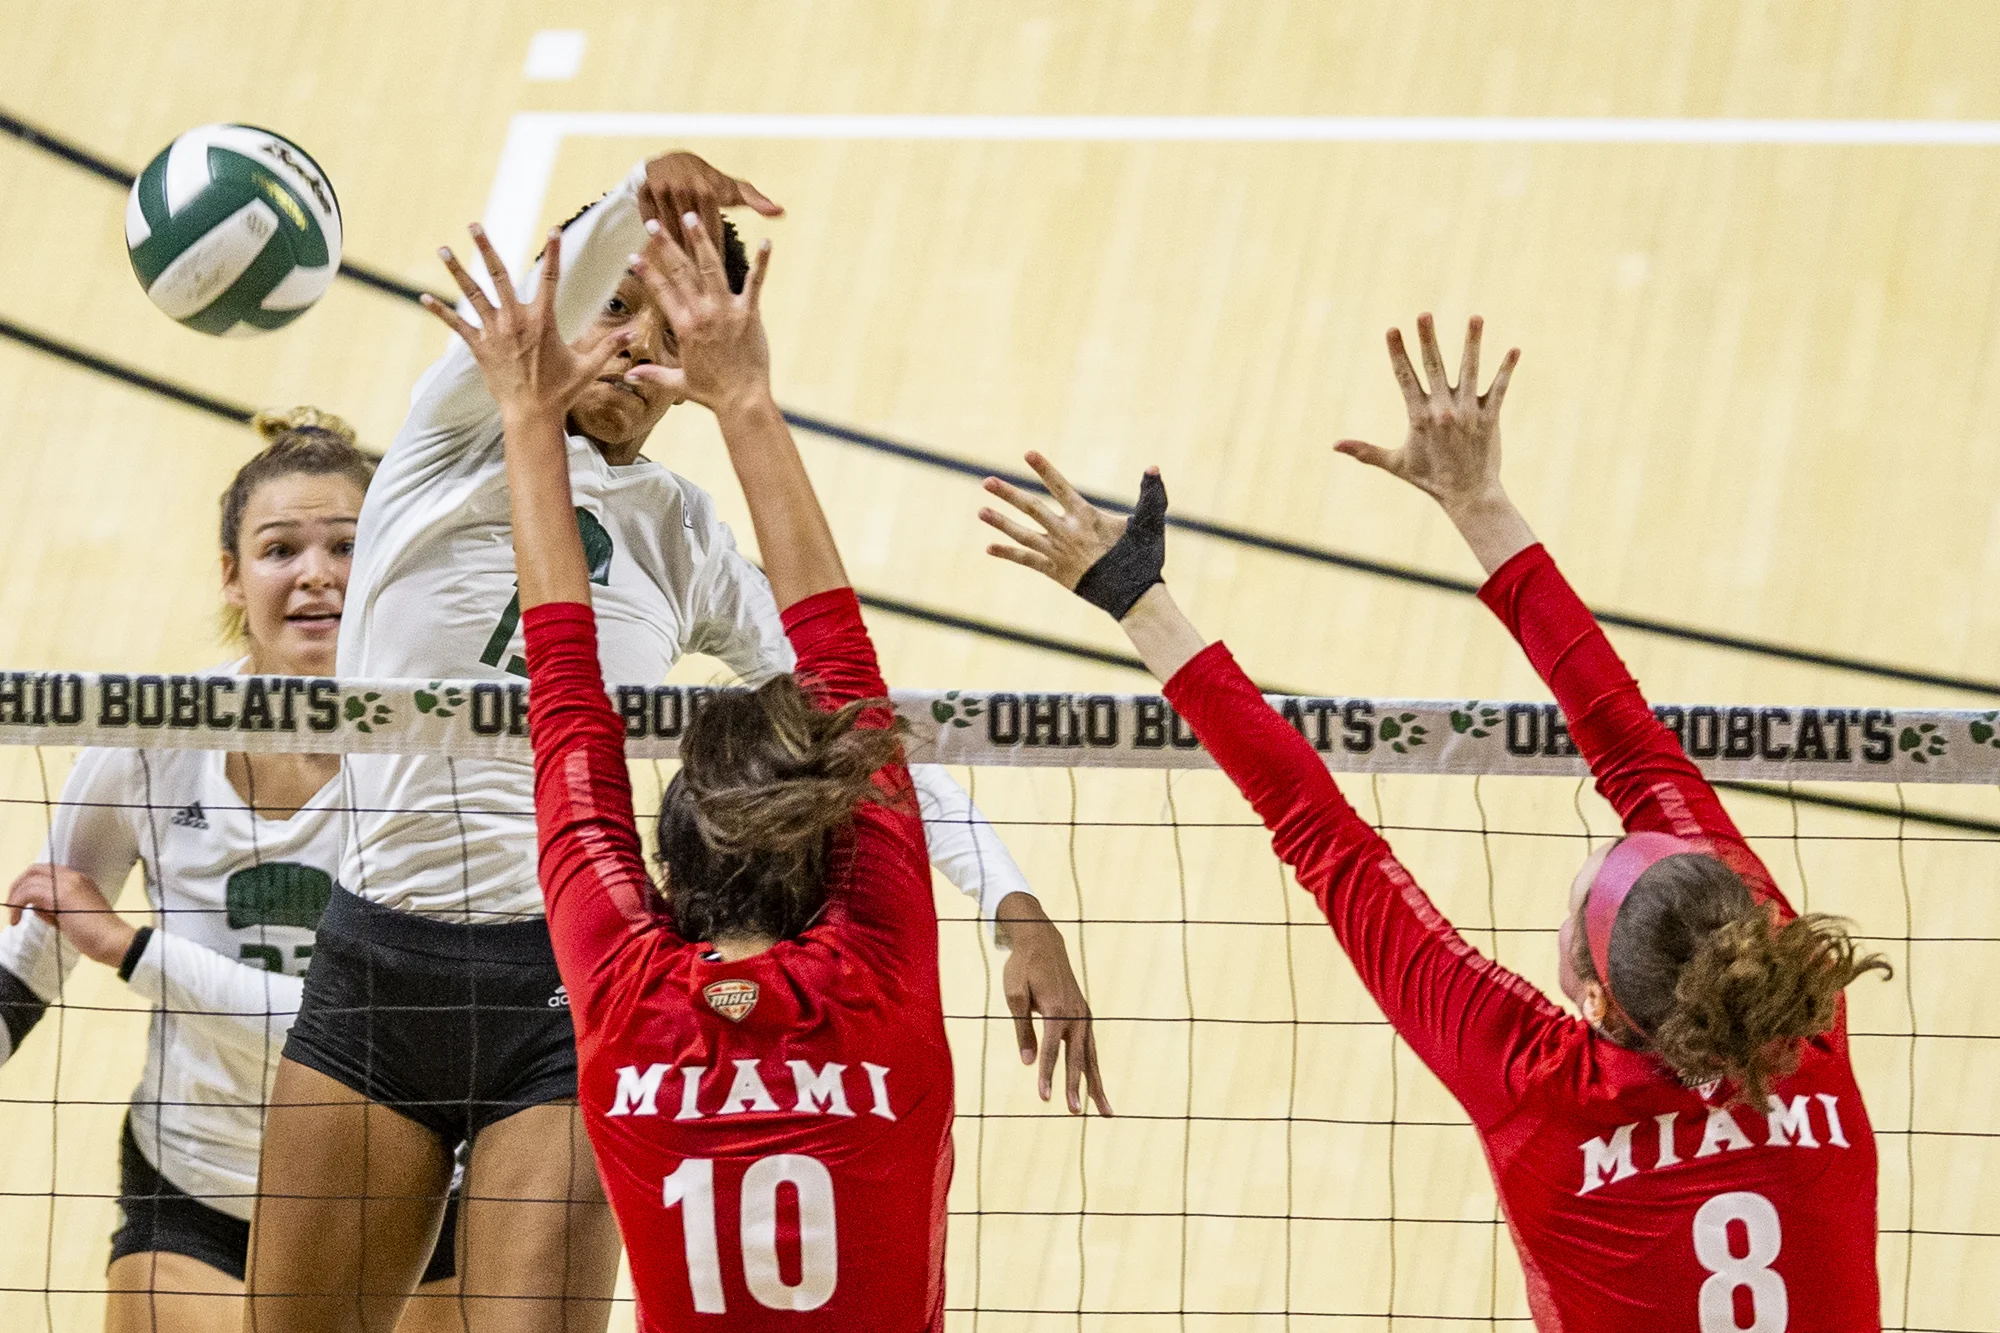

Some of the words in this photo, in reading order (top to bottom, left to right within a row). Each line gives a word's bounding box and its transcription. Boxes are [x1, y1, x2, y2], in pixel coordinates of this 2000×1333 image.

[0, 672, 84, 724] HIO
[98, 674, 340, 732] BOBCATS
[988, 693, 1119, 748] OHIO
[604, 1058, 897, 1122] MIAMI
[1575, 1092, 1851, 1197] MIAMI
[662, 1153, 838, 1315] 10
[1692, 1190, 1789, 1333] 8
